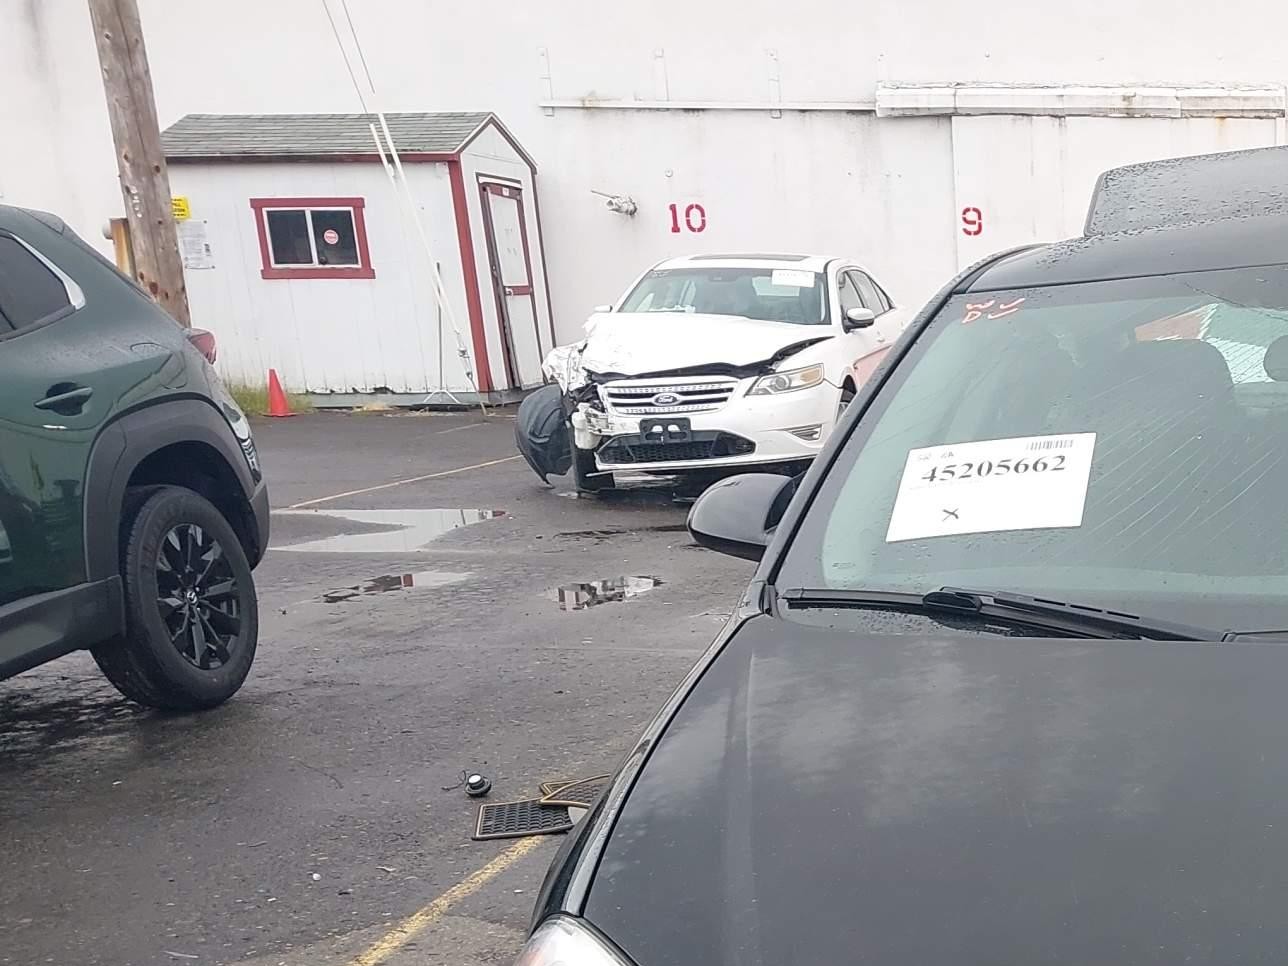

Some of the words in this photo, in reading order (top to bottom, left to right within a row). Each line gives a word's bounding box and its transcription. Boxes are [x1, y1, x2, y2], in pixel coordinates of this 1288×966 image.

[669, 203, 706, 233] 10
[962, 207, 982, 236] 9
[920, 454, 1067, 483] 45205662
